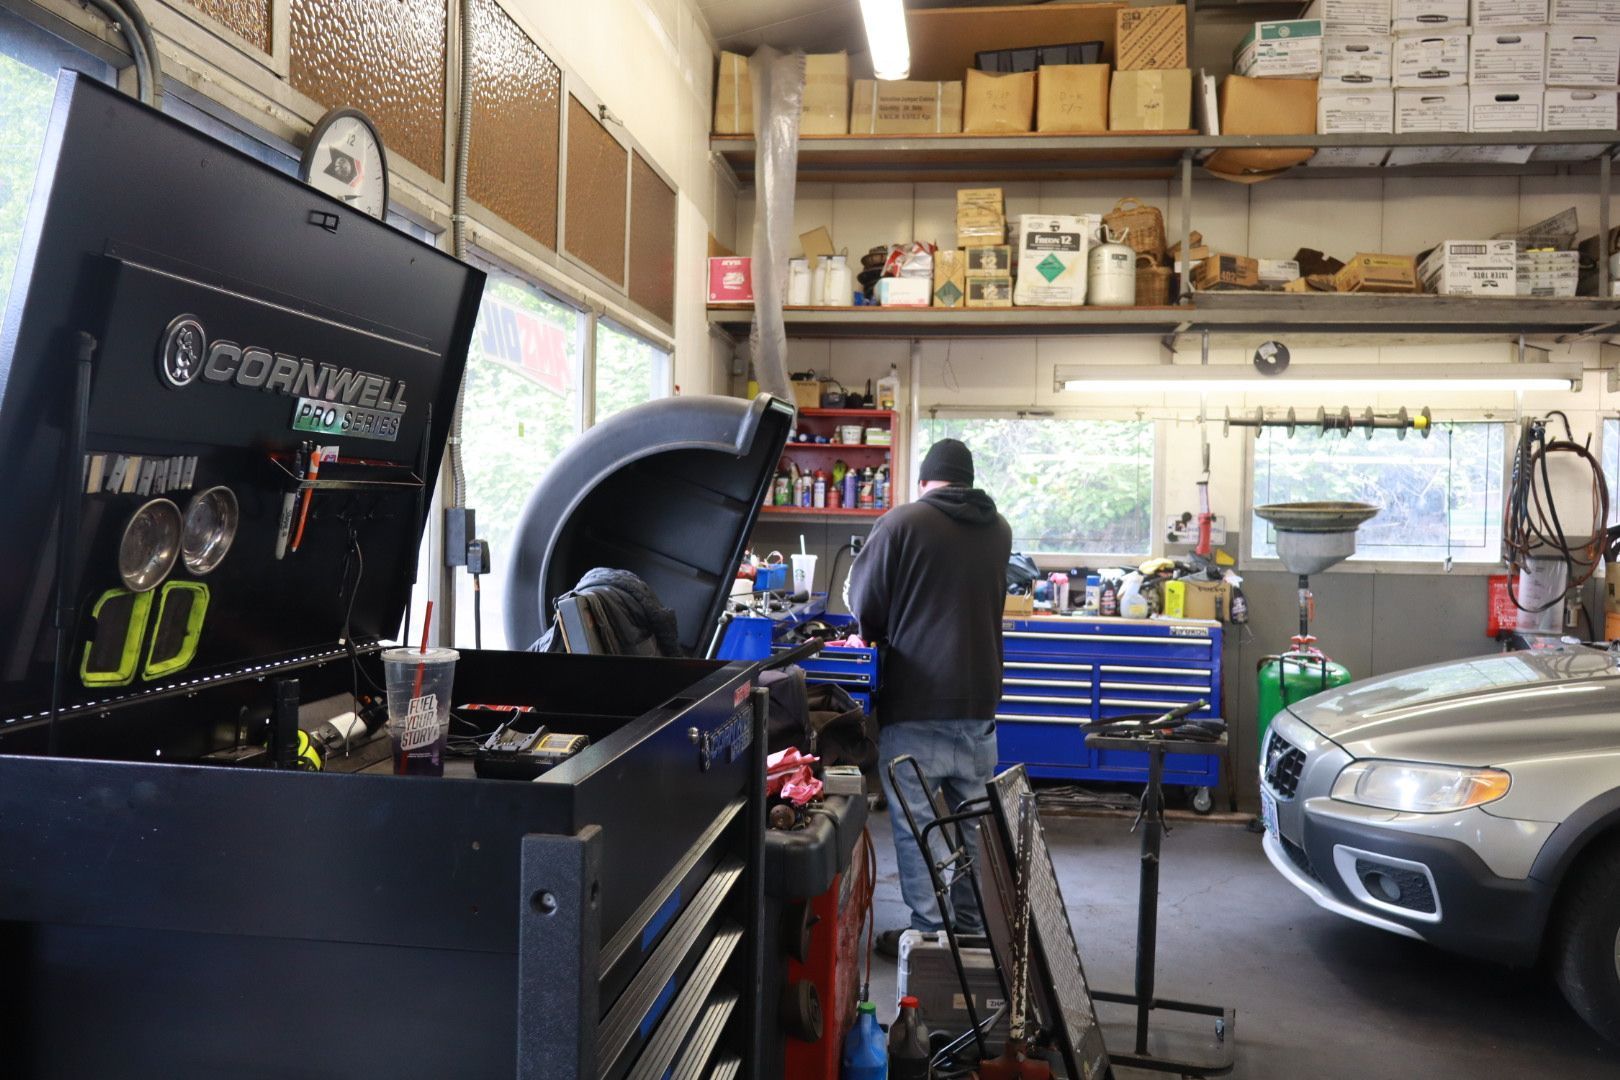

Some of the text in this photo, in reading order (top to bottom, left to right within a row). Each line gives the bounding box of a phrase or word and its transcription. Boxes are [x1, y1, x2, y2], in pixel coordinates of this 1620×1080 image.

[347, 134, 356, 147] 12
[1061, 235, 1072, 245] 12
[204, 340, 407, 413] CORNWELL
[298, 403, 399, 436] PRO SERIES
[410, 695, 434, 715] FUEL
[405, 711, 434, 731] YOUR
[402, 725, 434, 748] STORY
